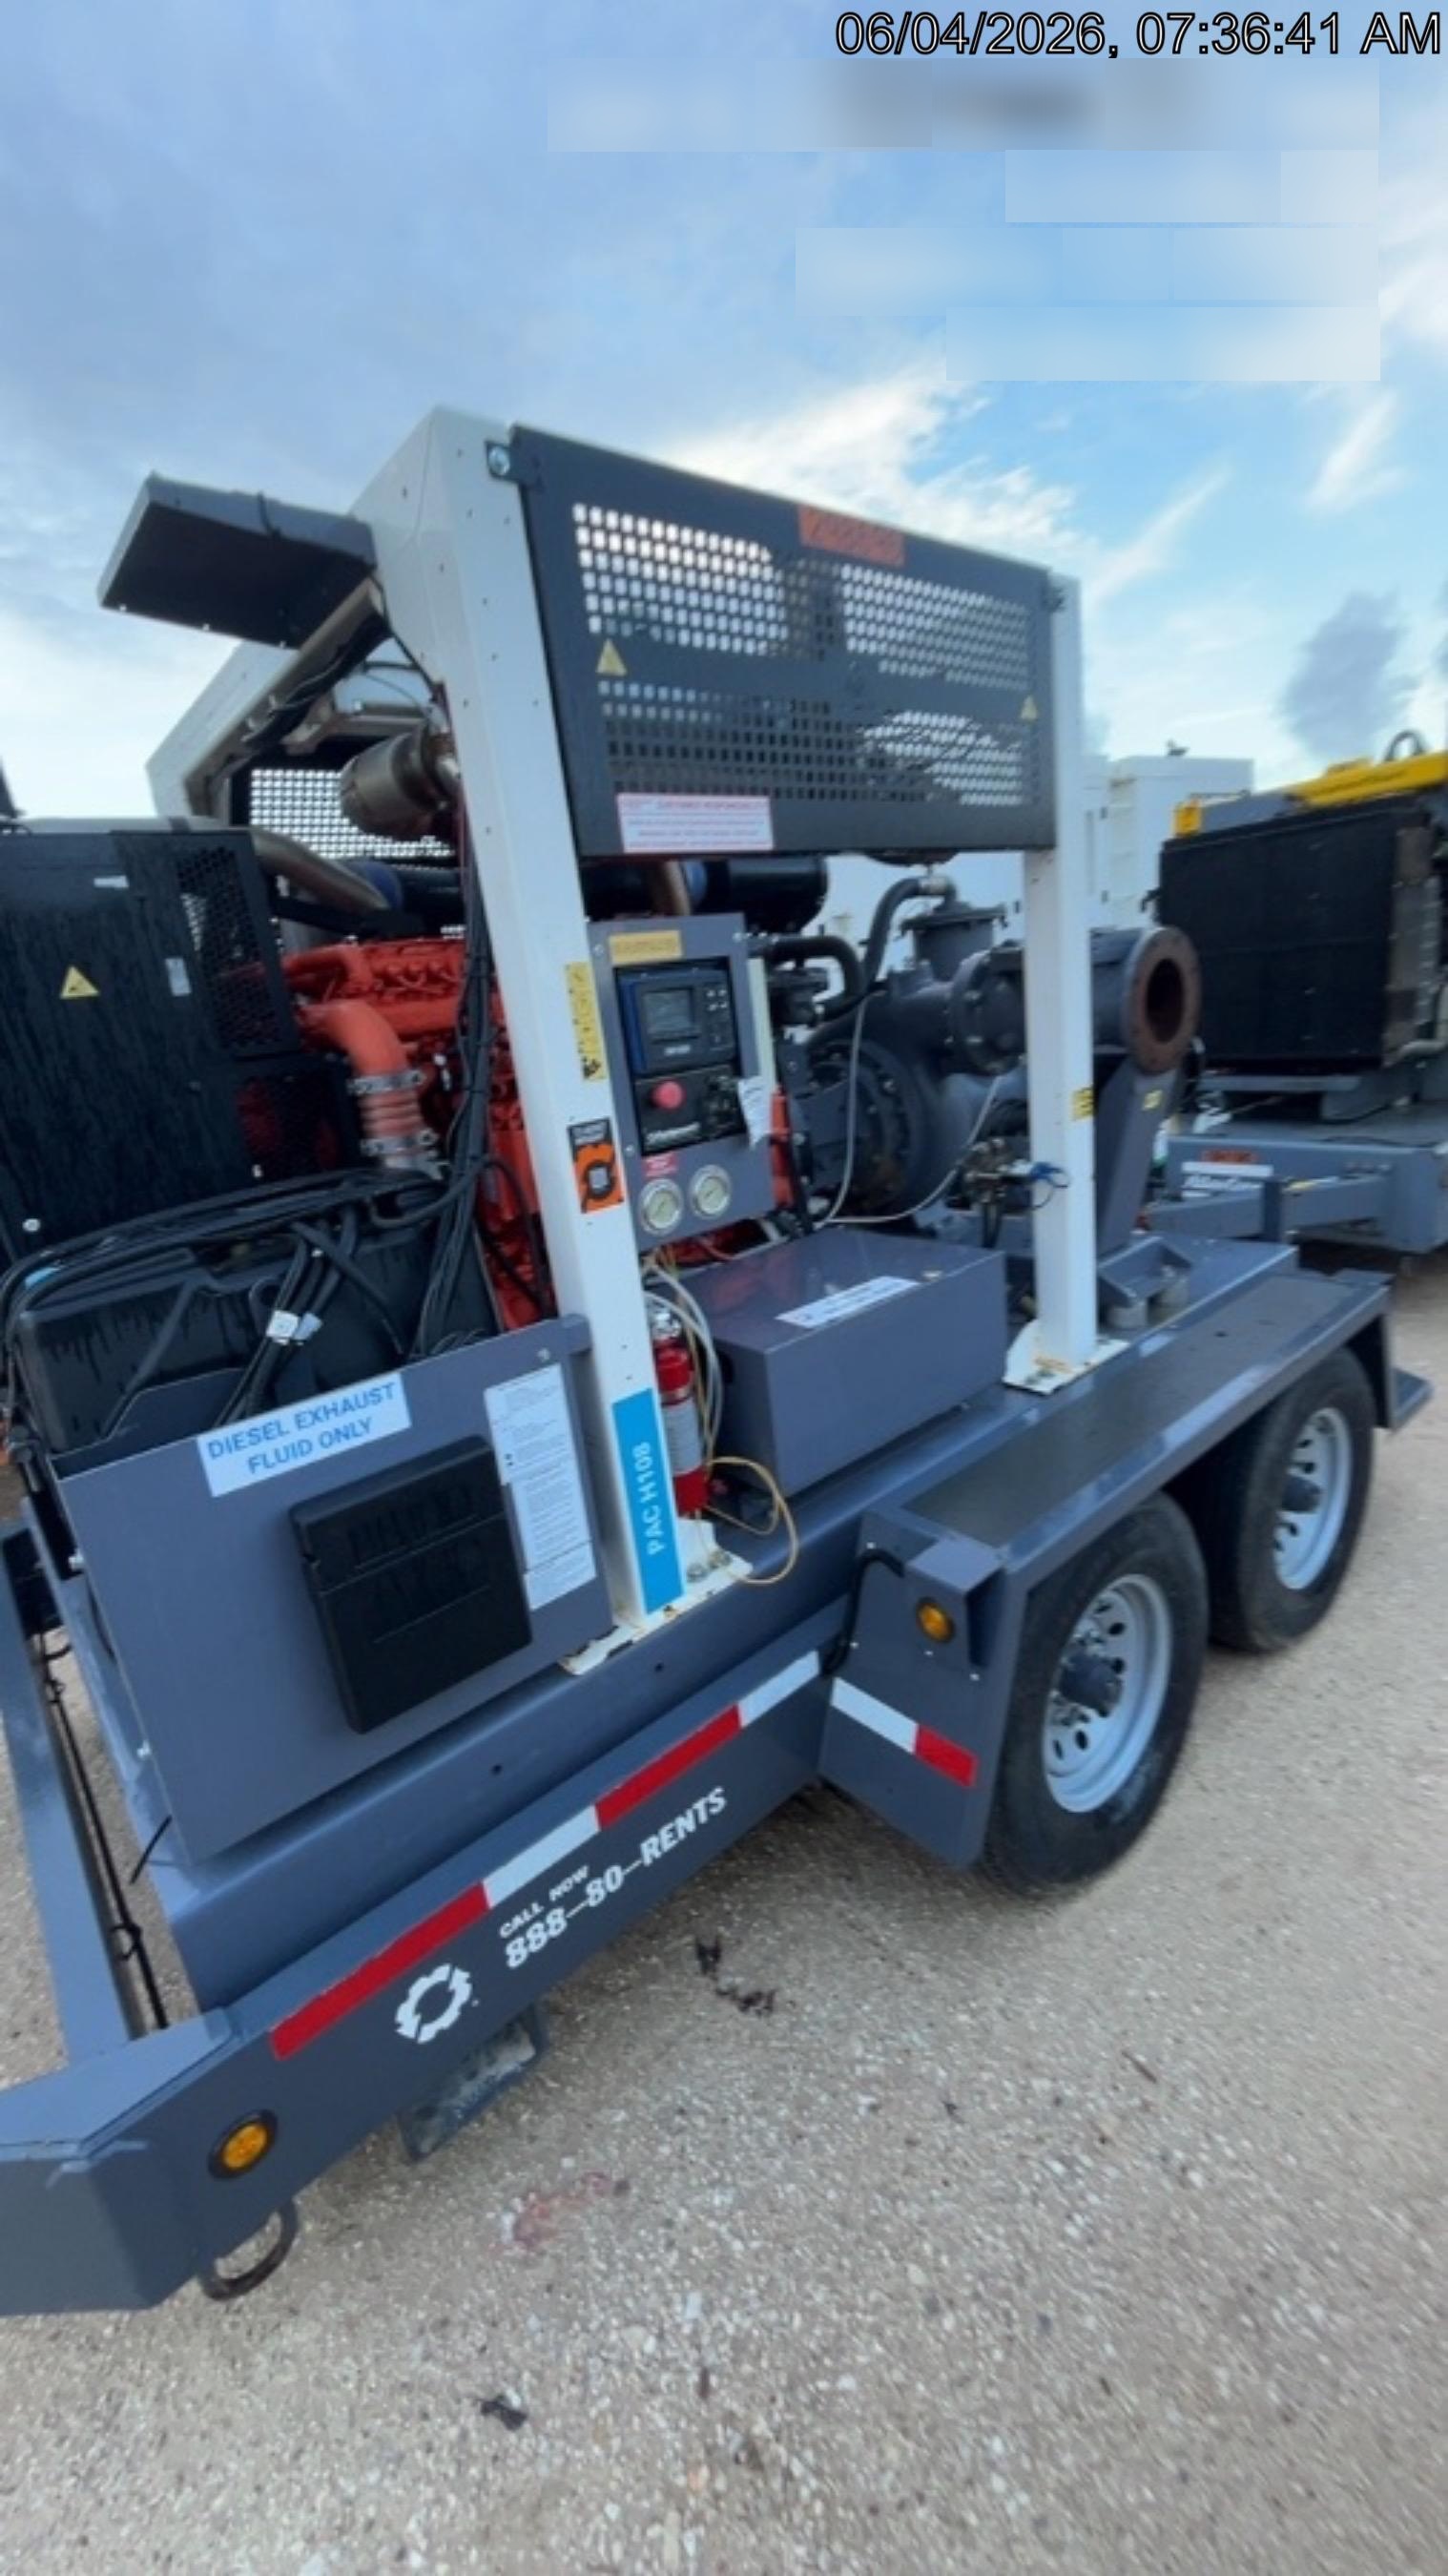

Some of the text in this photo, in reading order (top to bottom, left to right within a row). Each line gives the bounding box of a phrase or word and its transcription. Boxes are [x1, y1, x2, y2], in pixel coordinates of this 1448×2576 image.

[207, 1381, 395, 1459] DIESEL EXHAUST
[247, 1416, 373, 1474] FLUID ONLY
[642, 1505, 666, 1555] PAC
[499, 1864, 590, 1939] CALL NOW
